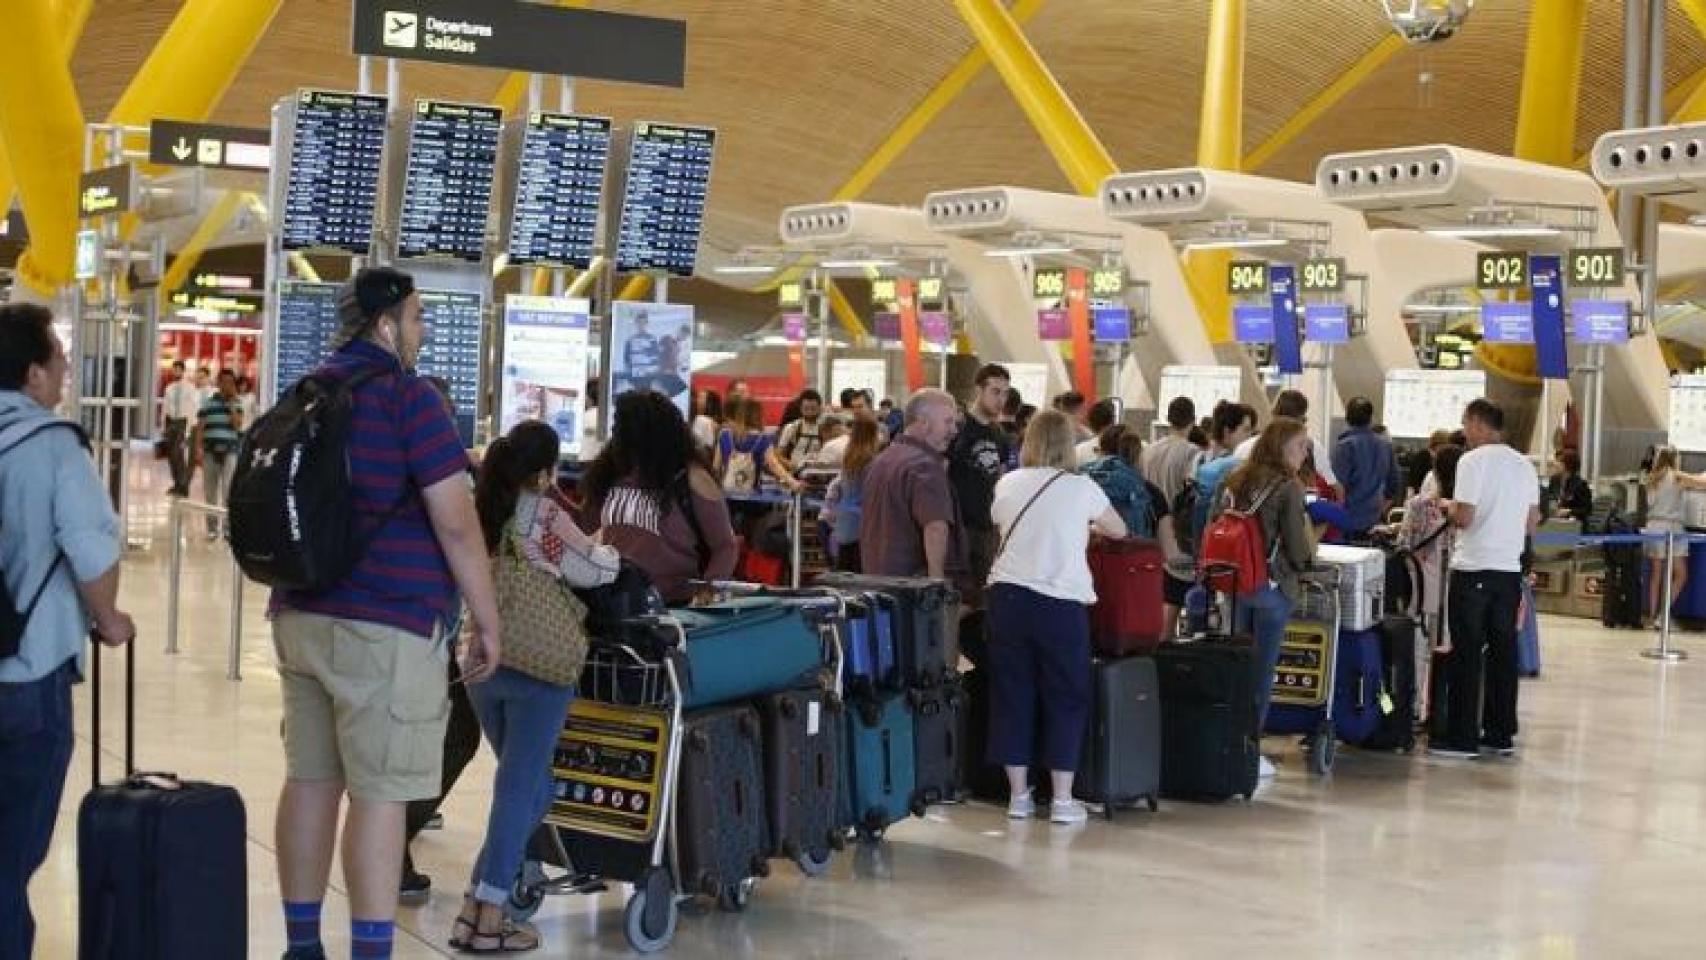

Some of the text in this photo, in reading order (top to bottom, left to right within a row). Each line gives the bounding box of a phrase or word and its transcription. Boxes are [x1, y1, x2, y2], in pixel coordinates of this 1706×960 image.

[426, 17, 492, 36] Departures
[425, 34, 476, 53] Salidas
[1231, 266, 1263, 289] 904
[1303, 263, 1337, 288] 903
[1482, 257, 1523, 284] 902
[1574, 254, 1615, 281] 901
[1037, 272, 1064, 295] 906
[1093, 271, 1122, 293] 905
